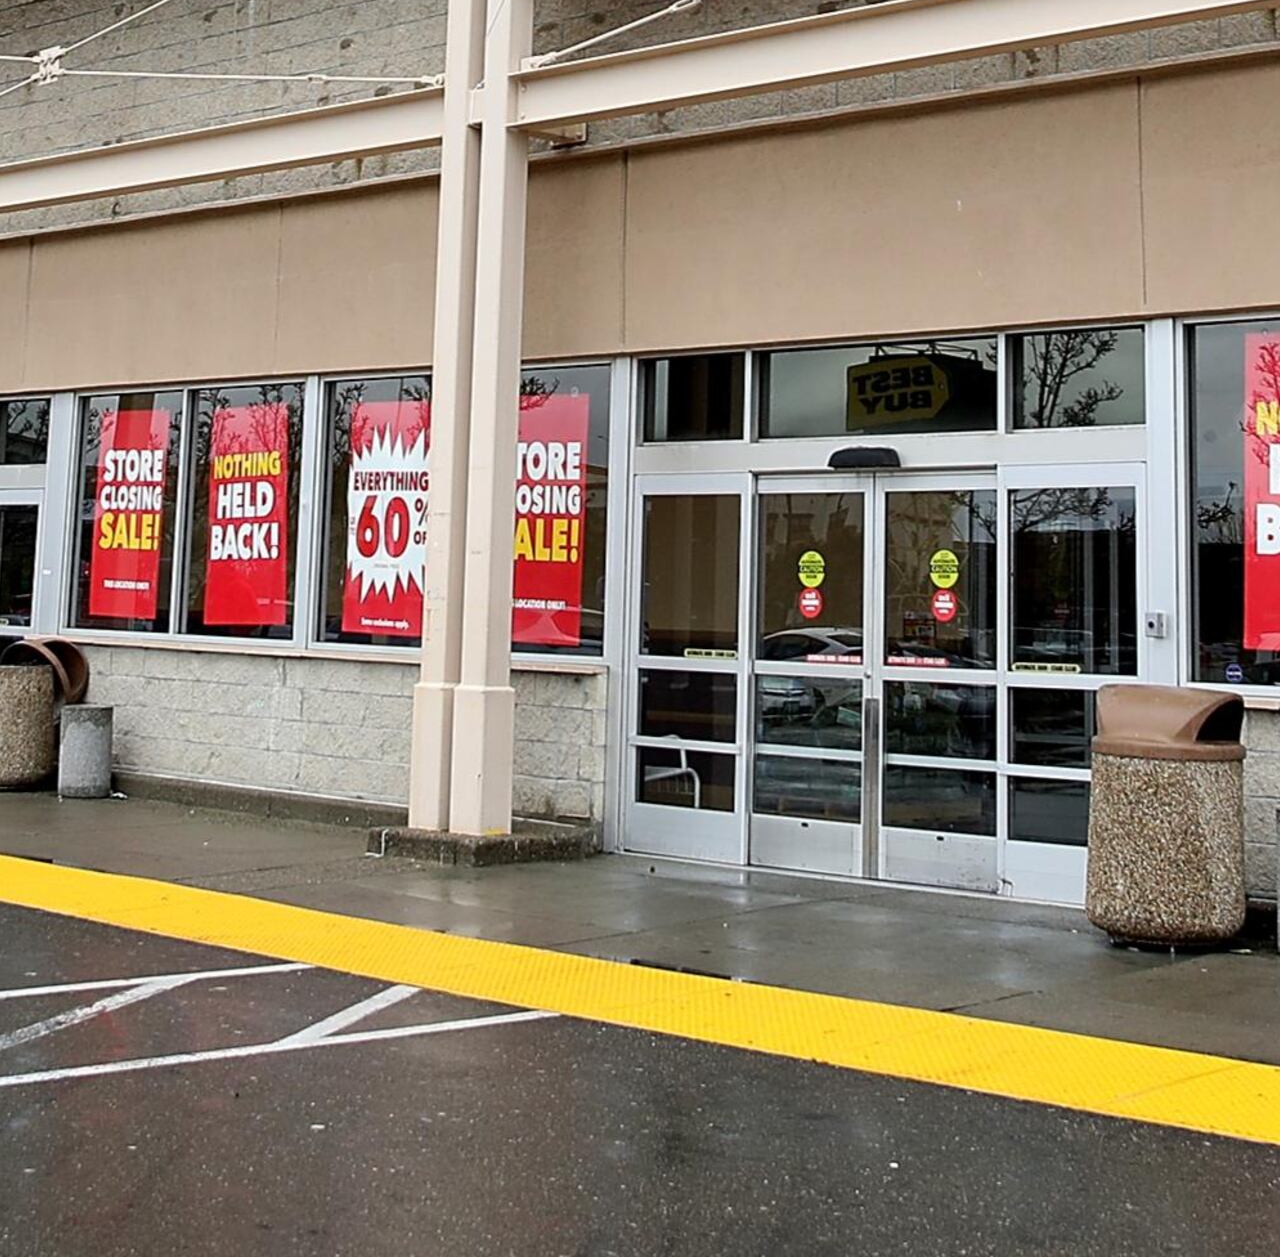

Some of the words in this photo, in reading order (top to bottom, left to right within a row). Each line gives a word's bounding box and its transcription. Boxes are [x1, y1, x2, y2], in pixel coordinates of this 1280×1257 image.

[103, 449, 164, 482] STORE
[214, 450, 281, 480] NOTHING
[516, 441, 581, 480] TORE
[354, 471, 429, 491] EVERYTHING
[100, 485, 162, 511] CLOSING
[216, 481, 275, 520] HELD
[516, 484, 581, 515] OSING
[99, 512, 160, 550] SALE!
[210, 522, 279, 561] BACK!
[414, 531, 427, 545] OF
[514, 518, 580, 563] ALE!
